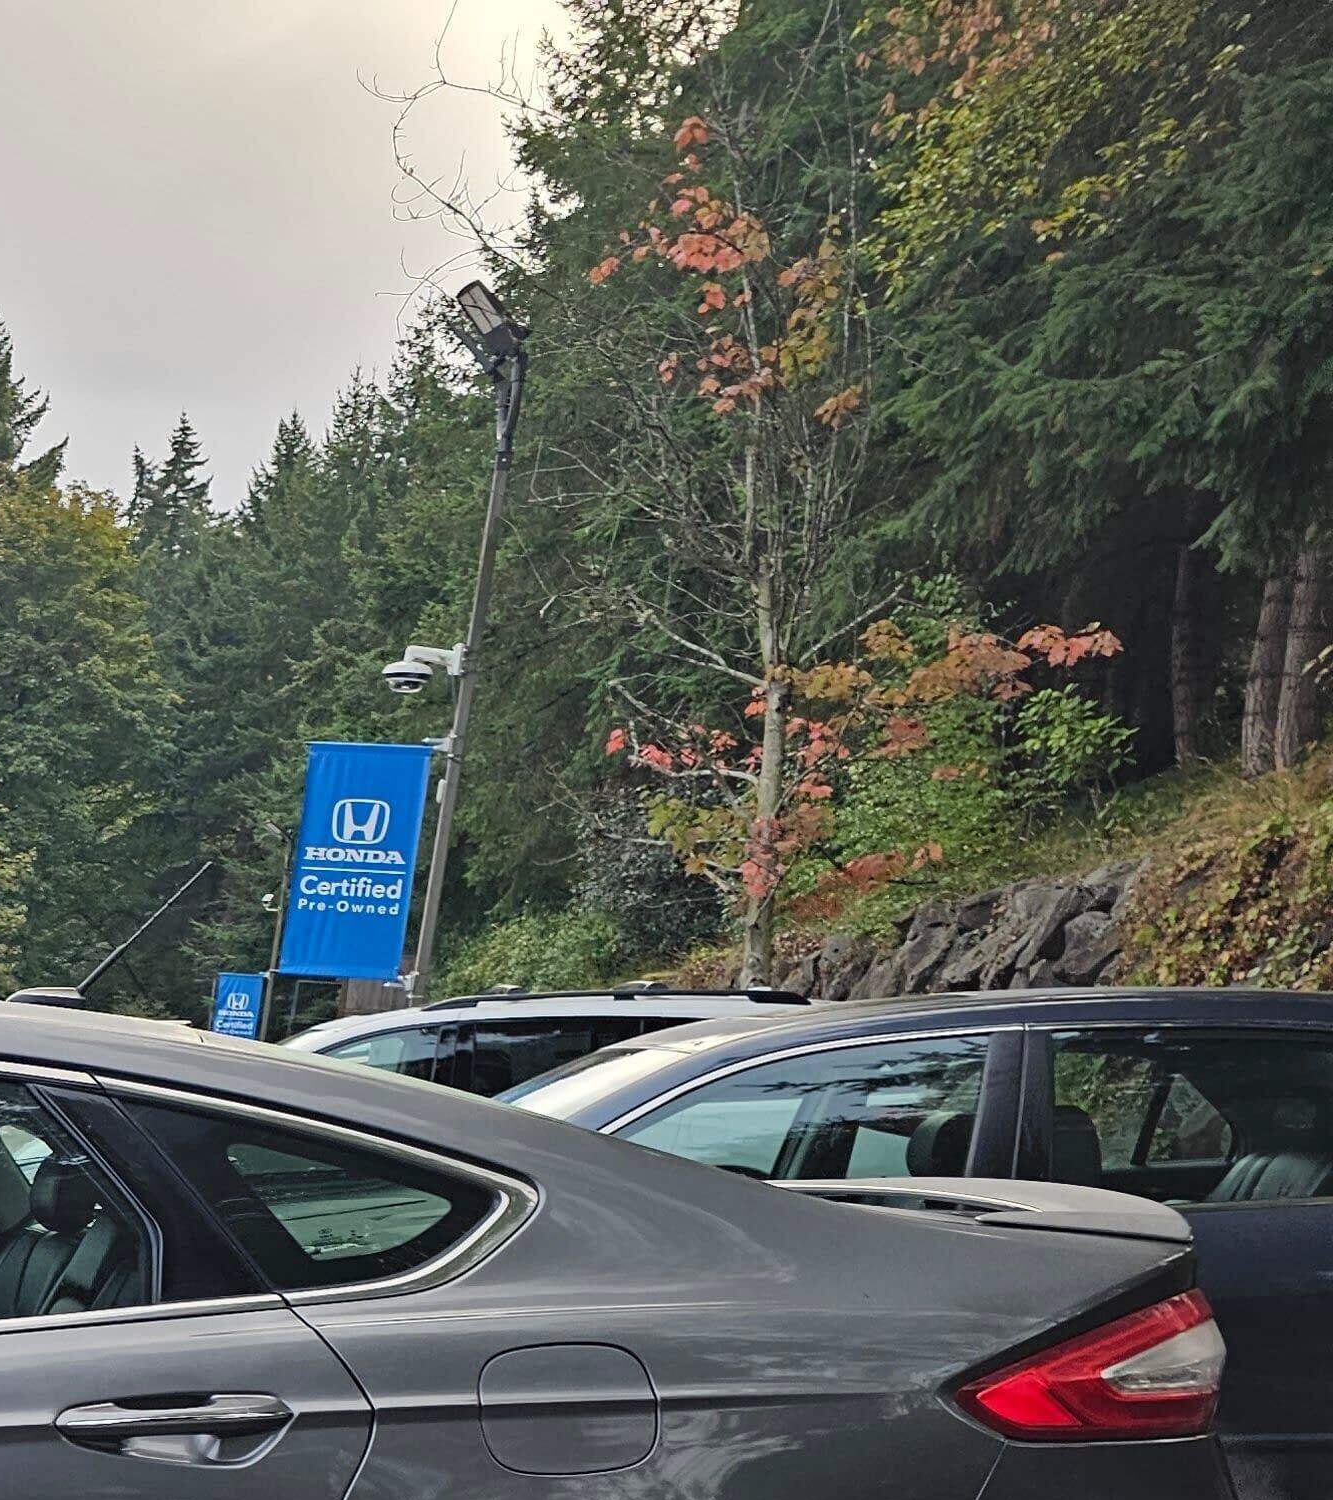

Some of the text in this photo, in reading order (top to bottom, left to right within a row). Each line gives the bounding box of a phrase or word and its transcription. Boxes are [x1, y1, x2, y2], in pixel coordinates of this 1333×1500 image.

[304, 847, 406, 864] HONDA
[300, 875, 403, 899] Certified
[298, 898, 399, 915] Pre-Owned
[217, 1009, 254, 1018] HONDA
